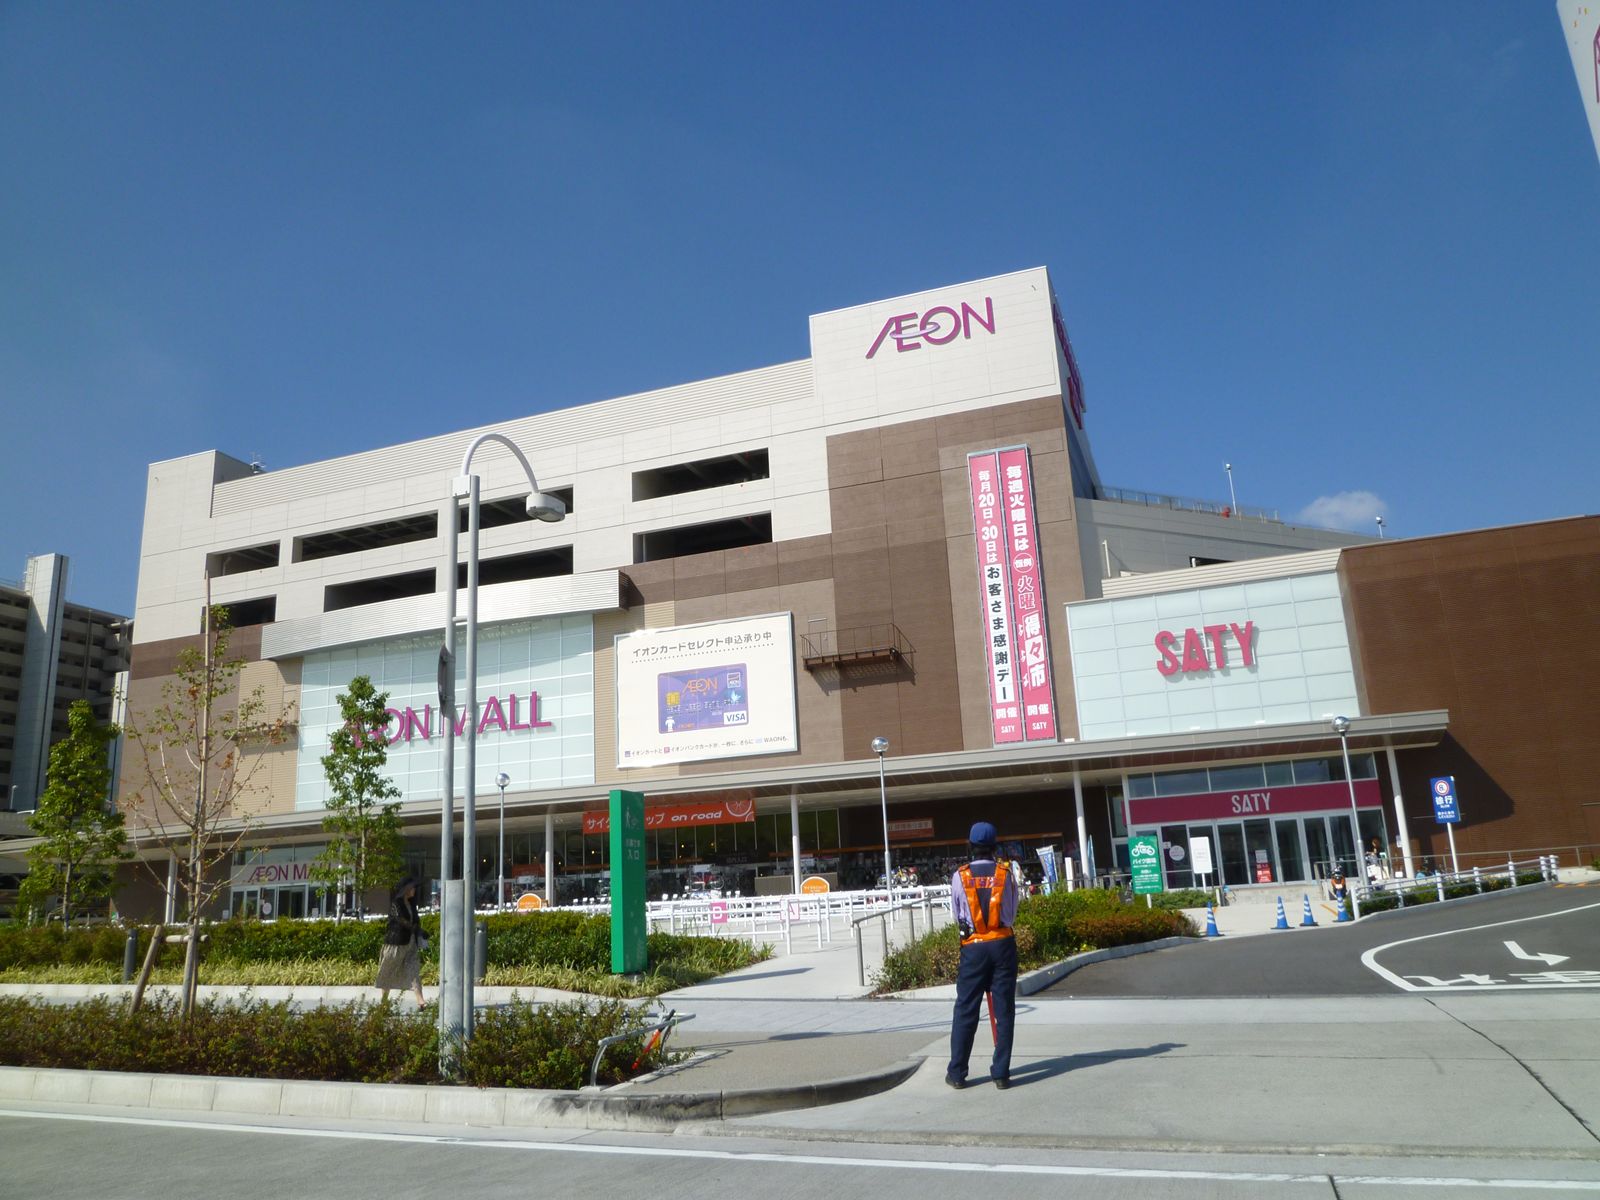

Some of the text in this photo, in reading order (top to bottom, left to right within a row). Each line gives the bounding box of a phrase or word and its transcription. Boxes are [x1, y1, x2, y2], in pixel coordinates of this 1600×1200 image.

[632, 631, 772, 657] イオンカードセレクト申込承り中
[1155, 620, 1254, 676] SATY
[726, 713, 746, 722] VISA
[1001, 725, 1015, 733] SATY
[1032, 722, 1047, 730] SATY
[1231, 792, 1271, 814] SATY
[671, 813, 688, 822] on
[691, 810, 722, 820] road
